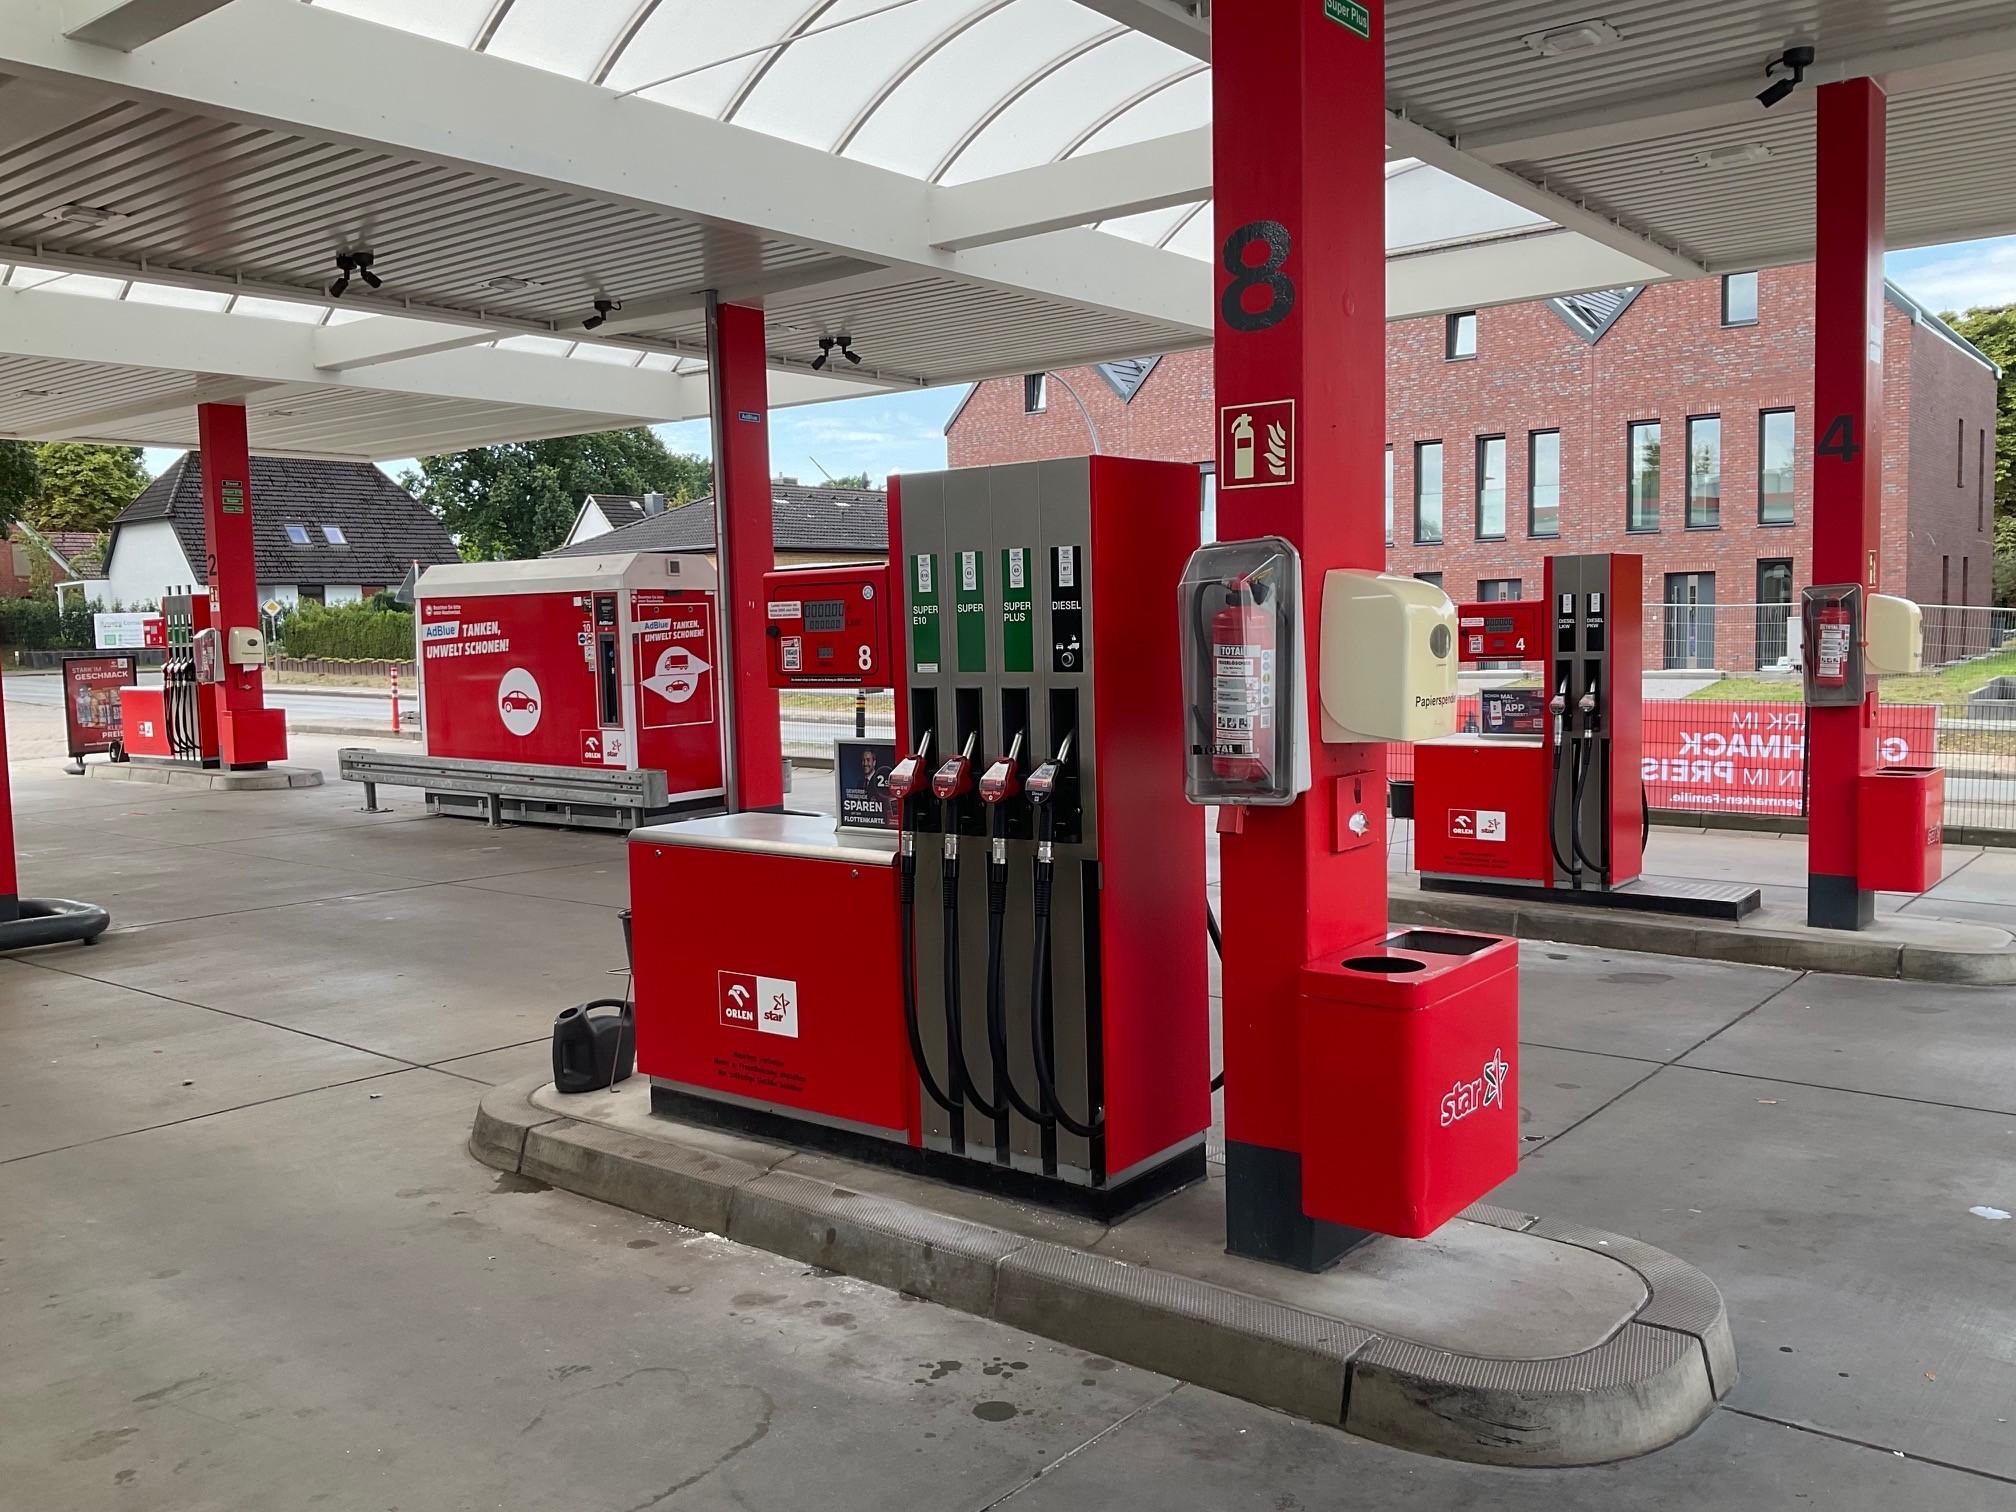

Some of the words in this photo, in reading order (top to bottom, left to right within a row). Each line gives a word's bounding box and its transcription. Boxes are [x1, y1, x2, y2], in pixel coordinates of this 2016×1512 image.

[1351, 7, 1367, 28] Plus
[1221, 221, 1295, 331] 8
[1818, 414, 1860, 463] 4
[208, 554, 218, 576] 2
[913, 605, 938, 614] SUPER
[957, 603, 984, 613] SUPER
[1003, 601, 1031, 611] SUPER
[1052, 600, 1082, 610] DIESEL
[913, 616, 927, 625] E10
[1003, 613, 1026, 622] PLUS
[426, 625, 456, 638] AdBlue
[462, 621, 501, 637] TANKEN,
[583, 623, 591, 632] 10
[644, 621, 669, 630] AdBlue
[673, 619, 700, 630] TANKEN,
[645, 631, 672, 643] UMWELT
[673, 628, 705, 640] SCHONEN!
[427, 642, 463, 658] UMWELT
[465, 639, 510, 656] SCHONEN!
[1515, 637, 1525, 651] 4
[1221, 646, 1245, 656] TOTAL
[858, 645, 872, 670] 8
[75, 670, 128, 681] GESCHMACK
[1504, 703, 1525, 712] APP
[843, 799, 883, 812] SPAREN
[844, 815, 886, 825] FLOTTENKARTE.
[725, 1008, 754, 1021] ORLEN
[763, 1009, 784, 1022] star
[1440, 1078, 1482, 1127] star
